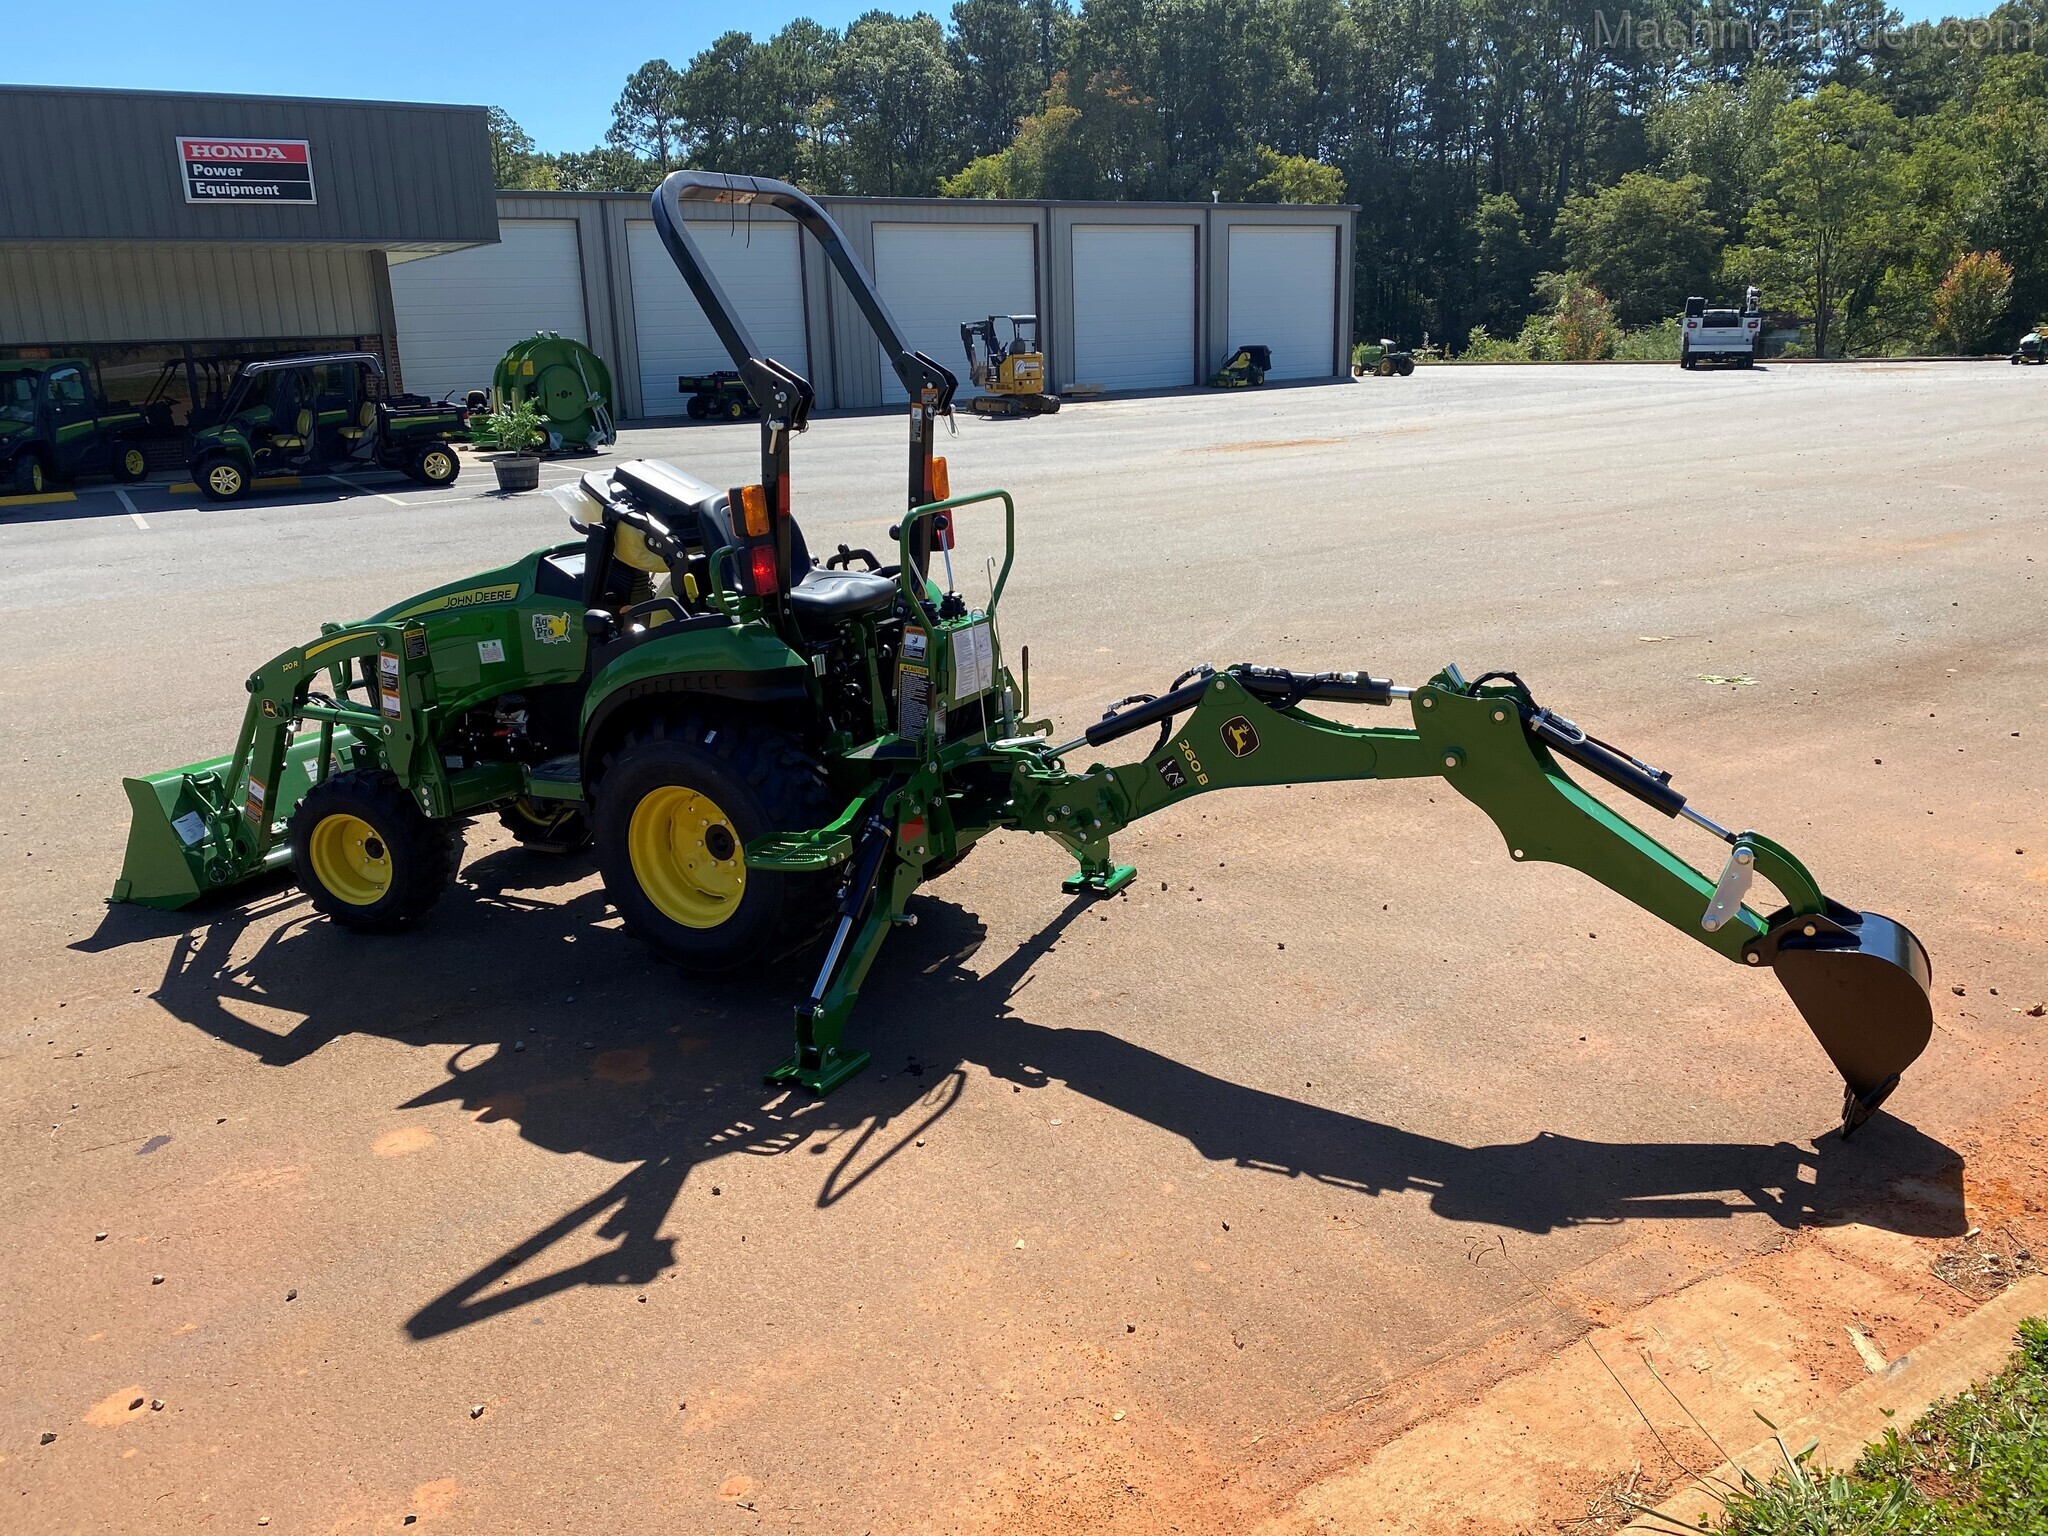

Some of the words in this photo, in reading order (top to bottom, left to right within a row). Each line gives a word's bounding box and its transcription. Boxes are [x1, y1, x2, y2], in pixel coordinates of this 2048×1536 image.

[189, 144, 287, 159] HONDA
[192, 163, 243, 177] Power
[195, 182, 280, 197] Equipment
[443, 594, 473, 608] JOHN
[475, 590, 512, 603] DEERE
[535, 627, 554, 638] Pro
